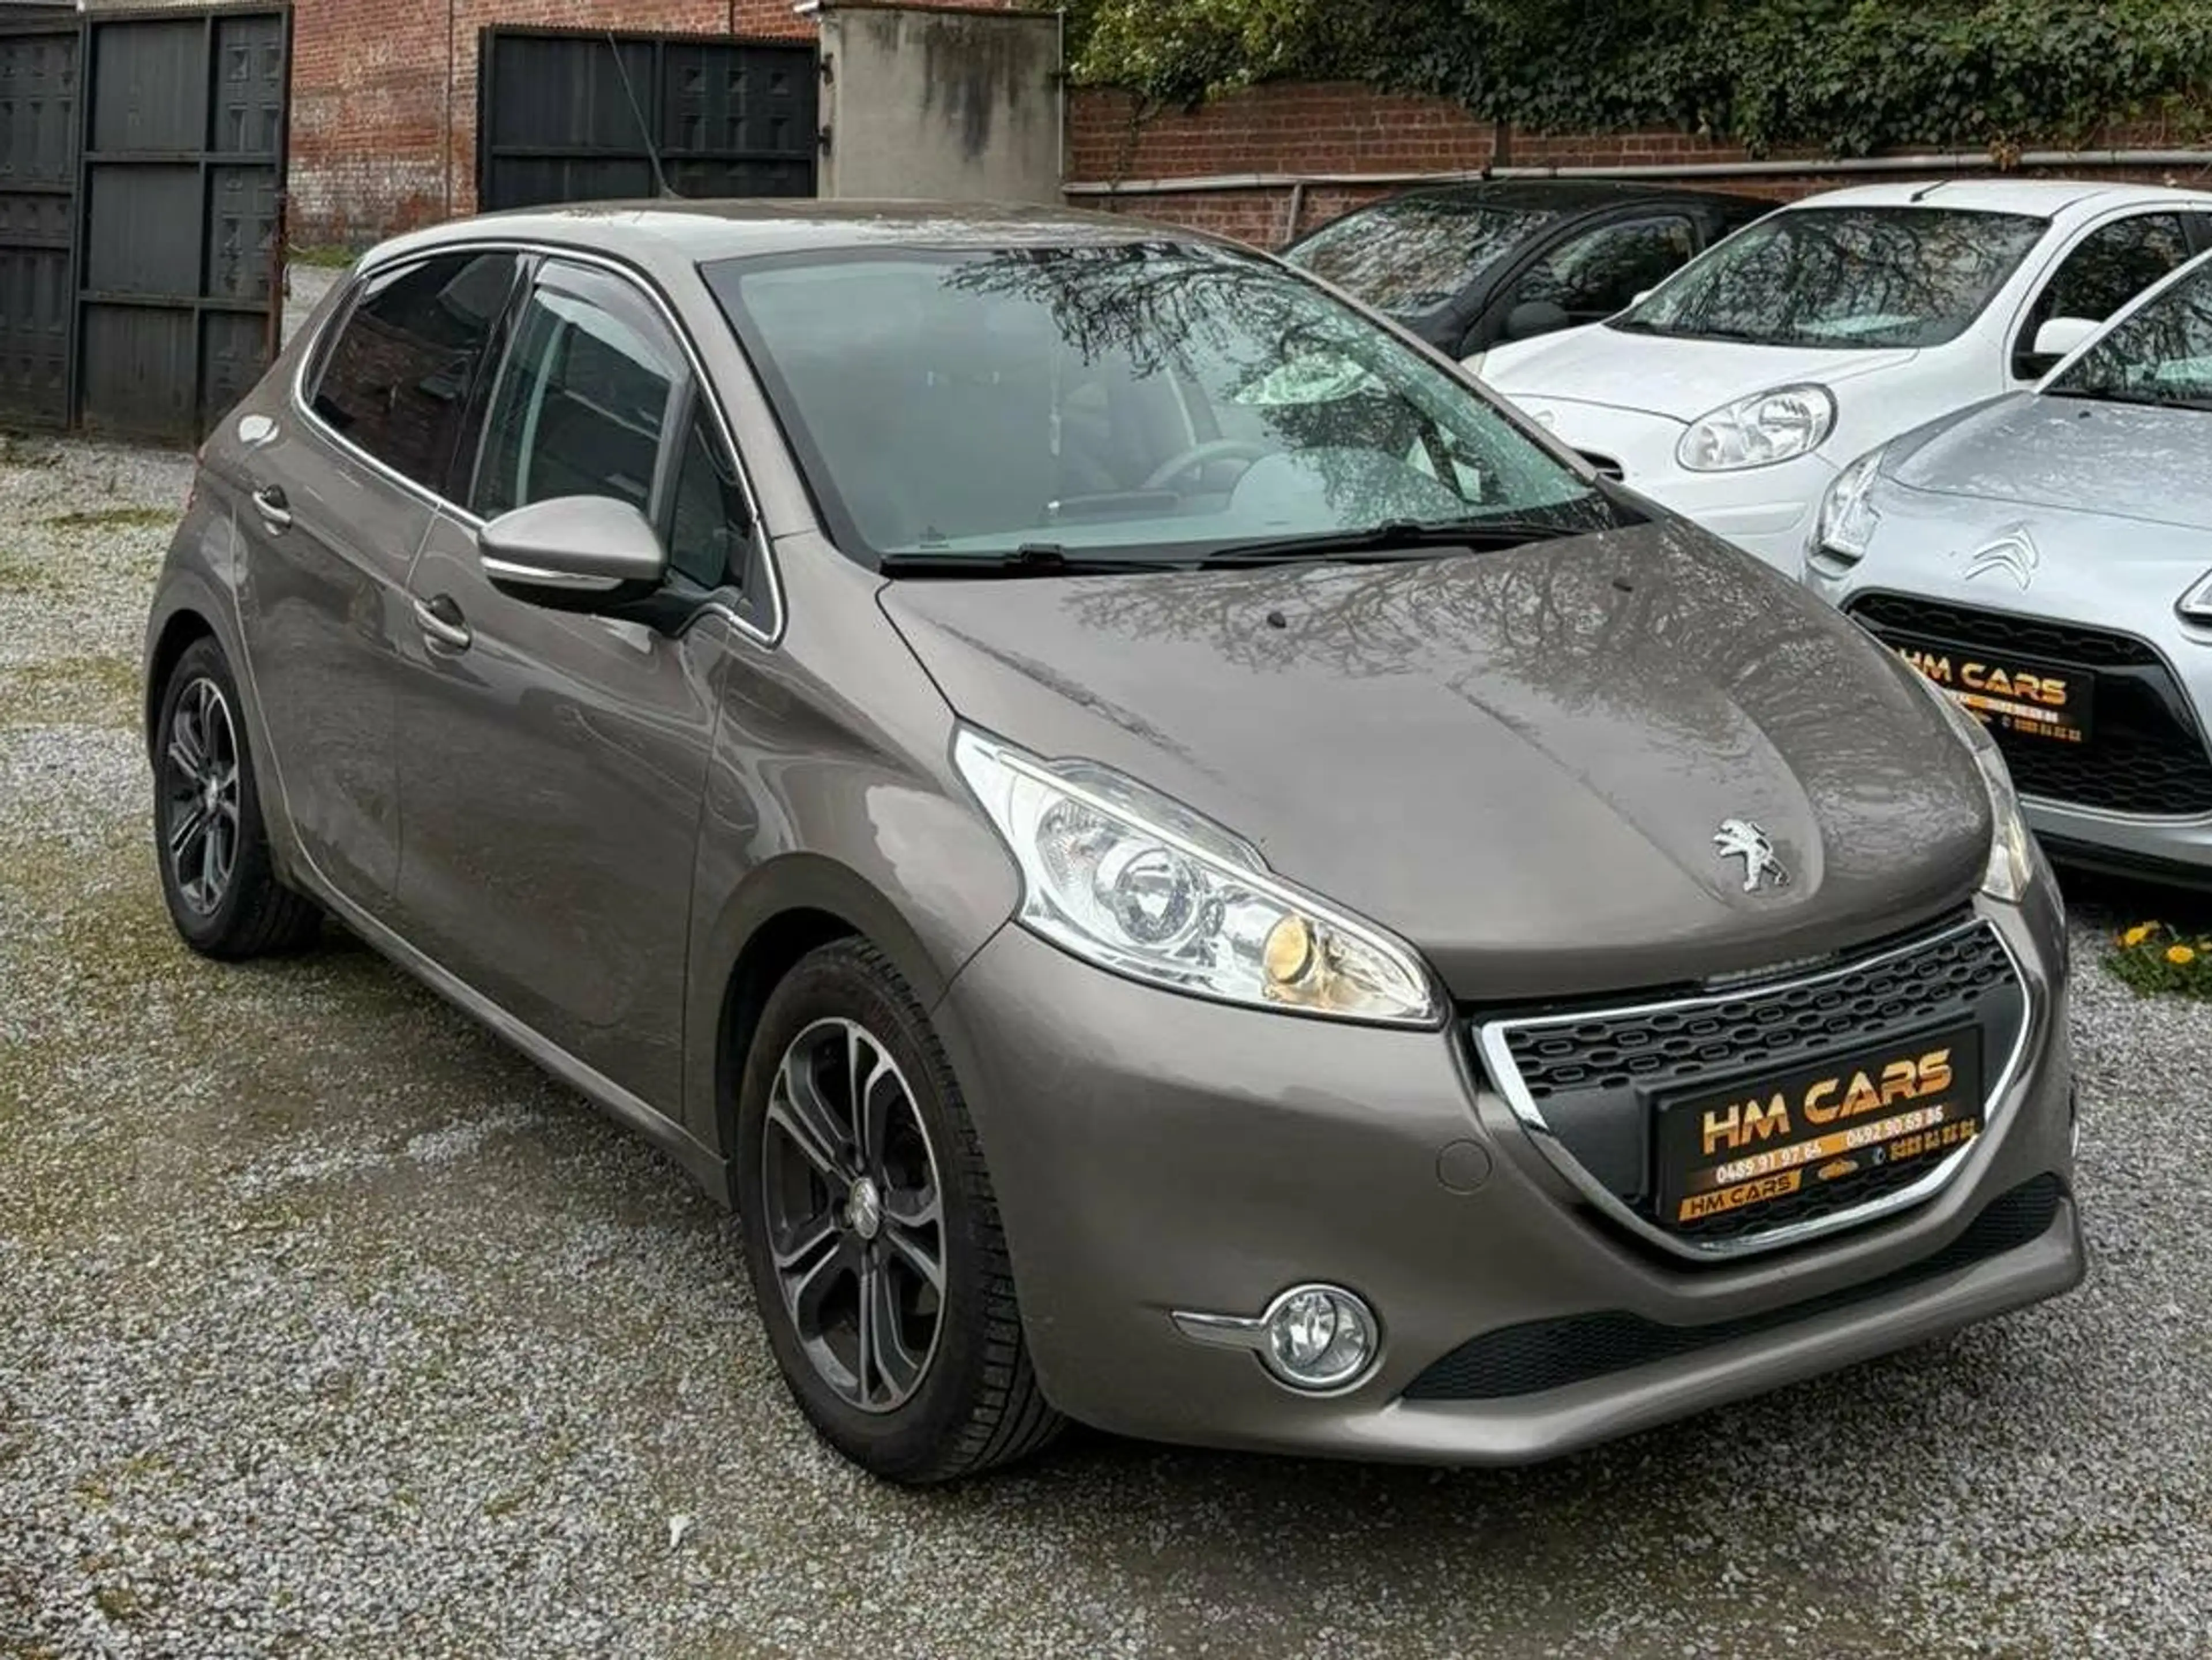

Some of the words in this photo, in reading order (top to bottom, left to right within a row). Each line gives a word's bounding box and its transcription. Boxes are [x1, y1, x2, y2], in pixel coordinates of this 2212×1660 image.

[1961, 663, 2067, 704] CARS
[1703, 1093, 1791, 1153] HM
[1805, 1049, 1951, 1125] CARS
[1691, 1194, 1723, 1214] HM
[1731, 1178, 1792, 1205] CARS
